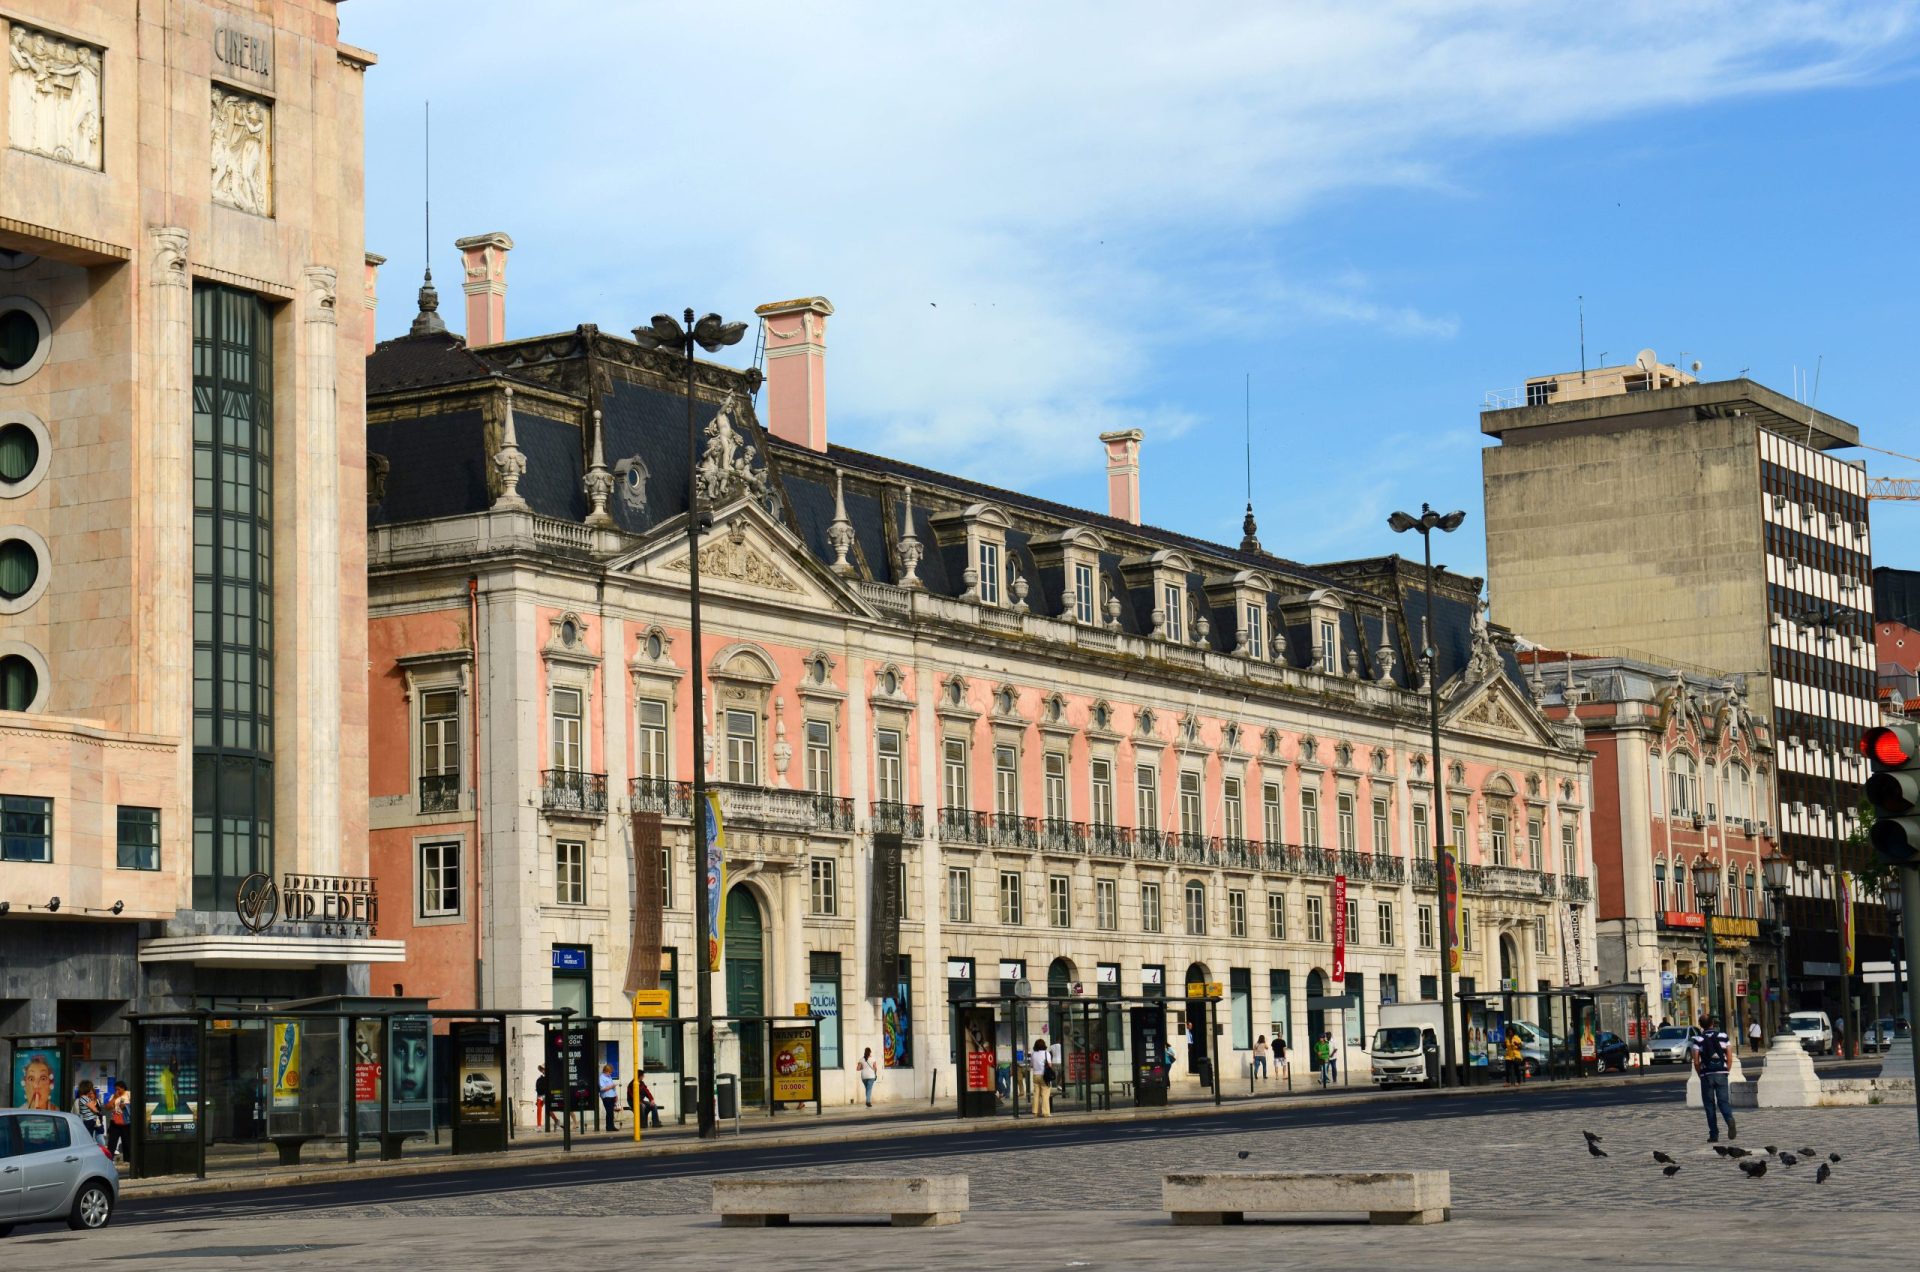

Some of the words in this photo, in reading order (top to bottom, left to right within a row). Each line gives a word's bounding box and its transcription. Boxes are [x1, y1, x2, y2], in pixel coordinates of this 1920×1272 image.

[214, 28, 269, 76] CINEMA
[284, 893, 316, 920] VIP
[323, 895, 378, 922] EDEN
[774, 1030, 811, 1039] WANTED
